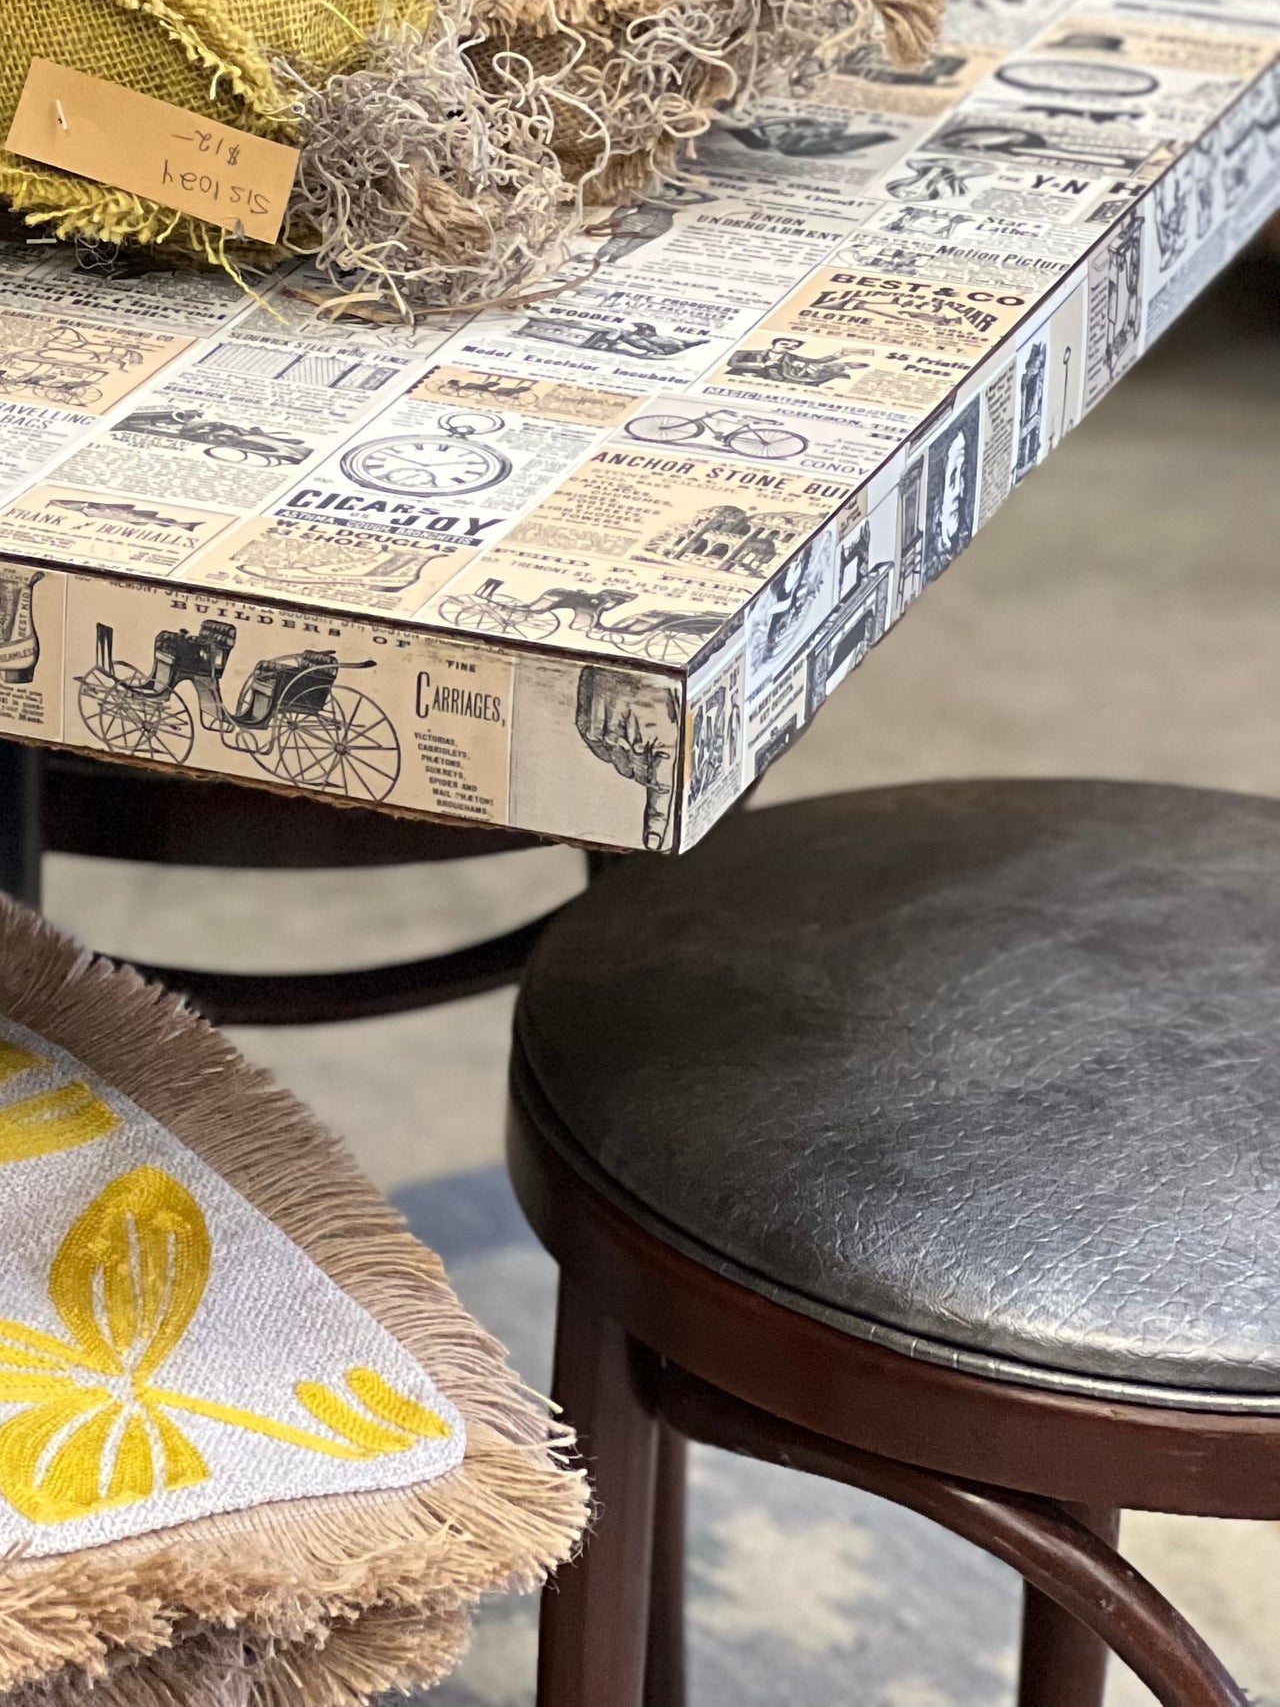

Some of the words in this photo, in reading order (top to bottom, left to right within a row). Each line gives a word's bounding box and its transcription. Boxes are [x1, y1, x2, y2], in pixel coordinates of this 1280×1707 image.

[749, 212, 807, 227] UNION
[936, 245, 1000, 264] Motion
[830, 273, 932, 293] BEST
[932, 287, 962, 297] &
[967, 292, 1025, 307] CO
[549, 307, 626, 324] WOODEN
[523, 354, 600, 372] Excelsior
[903, 364, 952, 377] Press
[0, 415, 55, 430] BAGS
[591, 451, 695, 475] ANCHOR
[706, 467, 794, 491] STONE
[3, 507, 68, 526] FRANK
[345, 520, 390, 533] COUGH
[396, 526, 476, 545] BRONCHITIS
[390, 515, 507, 537] JOY
[335, 529, 458, 554] DOUGLAS
[510, 560, 568, 575] TREMONT
[171, 599, 342, 638] BUILDERS
[373, 635, 411, 648] OF
[446, 660, 477, 673] FINE
[415, 671, 505, 727] CARRIAGES,
[429, 776, 458, 789] SPIDER
[461, 783, 478, 793] AND
[432, 788, 452, 798] MAIL
